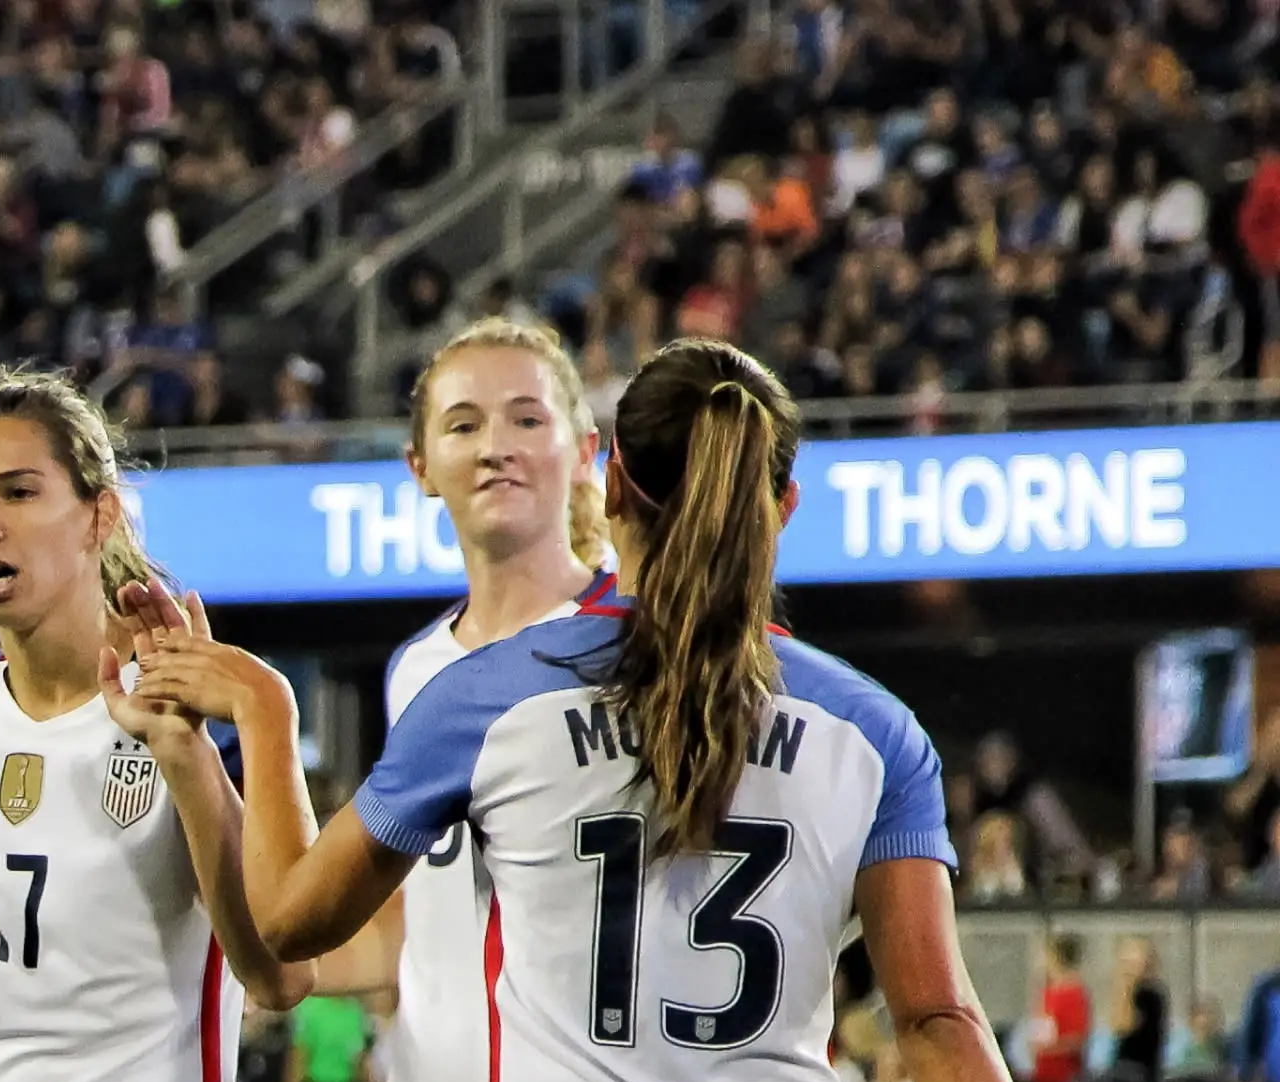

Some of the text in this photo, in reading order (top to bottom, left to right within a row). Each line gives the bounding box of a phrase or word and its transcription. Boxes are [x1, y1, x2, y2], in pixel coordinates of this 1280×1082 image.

[826, 448, 1187, 558] THORNE
[111, 759, 153, 785] USA
[574, 811, 794, 1051] 13
